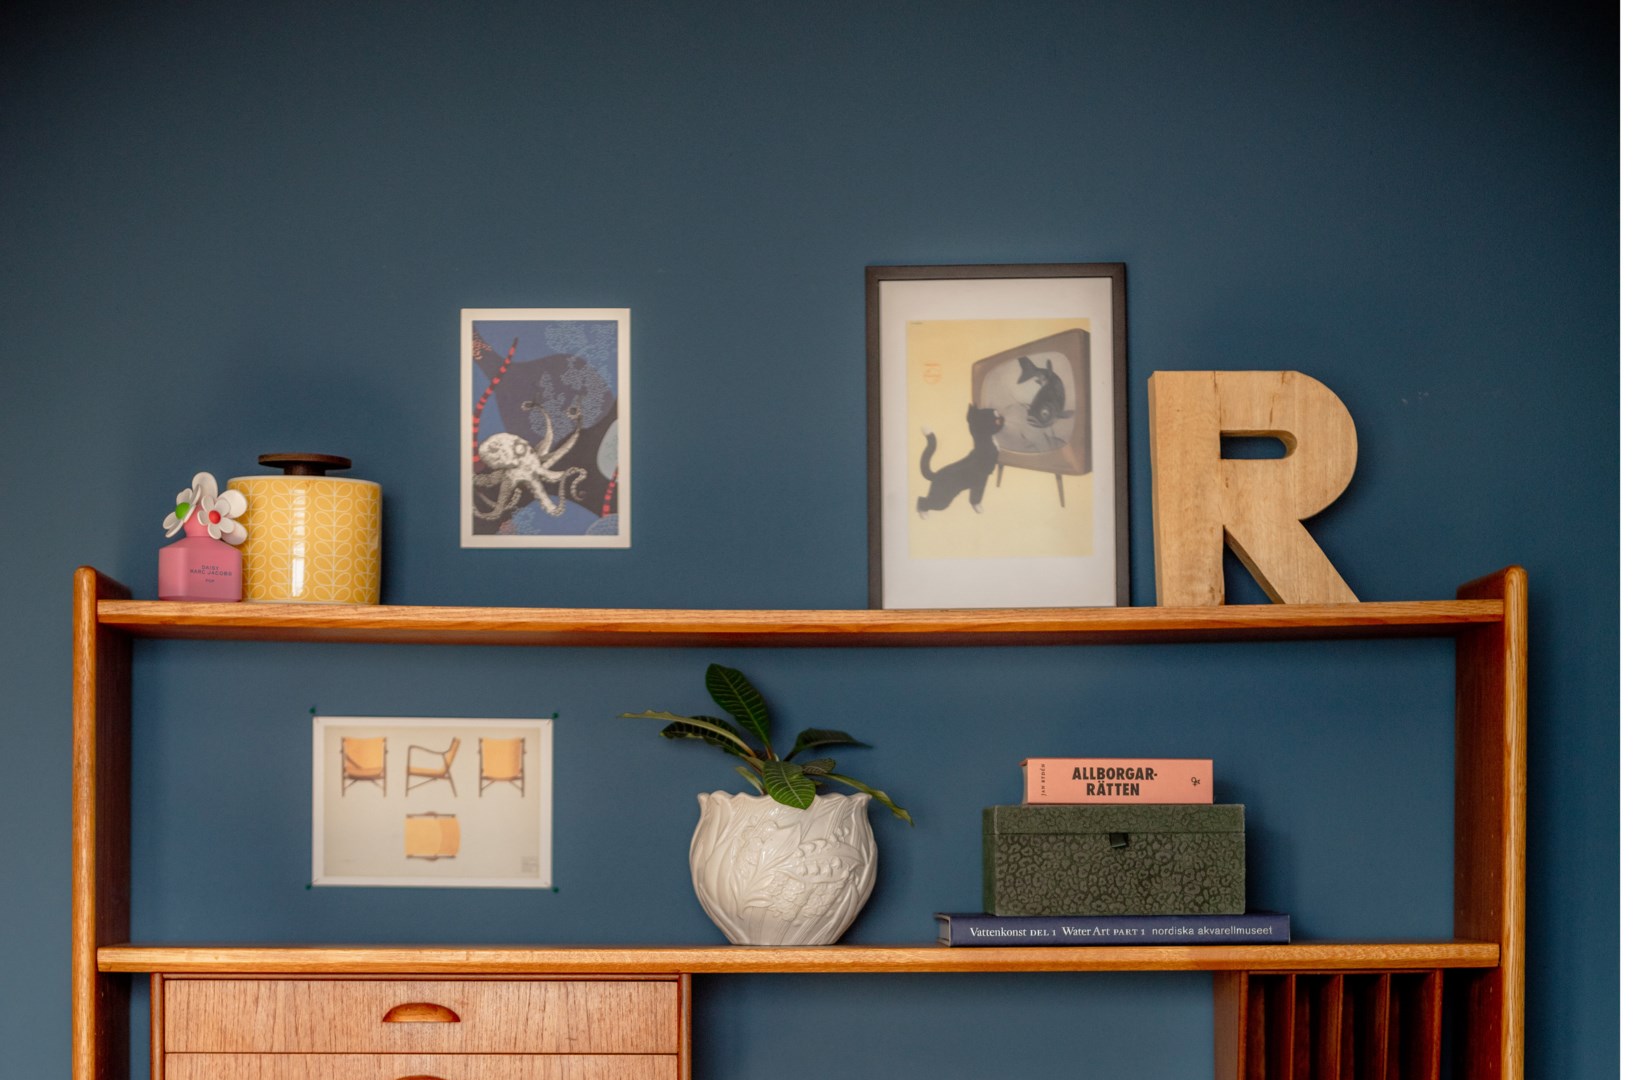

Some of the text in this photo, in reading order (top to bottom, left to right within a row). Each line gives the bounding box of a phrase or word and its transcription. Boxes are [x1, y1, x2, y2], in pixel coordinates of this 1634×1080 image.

[1148, 370, 1359, 606] R
[1072, 767, 1158, 781] ALLBORGAR-
[1086, 780, 1140, 797] RÄTTEN
[970, 927, 1027, 937] Vattenkonst
[1062, 926, 1091, 937] Water
[1092, 926, 1110, 937] Art
[1152, 926, 1194, 935] nordiska
[1197, 925, 1273, 936] akvarellmuseet
